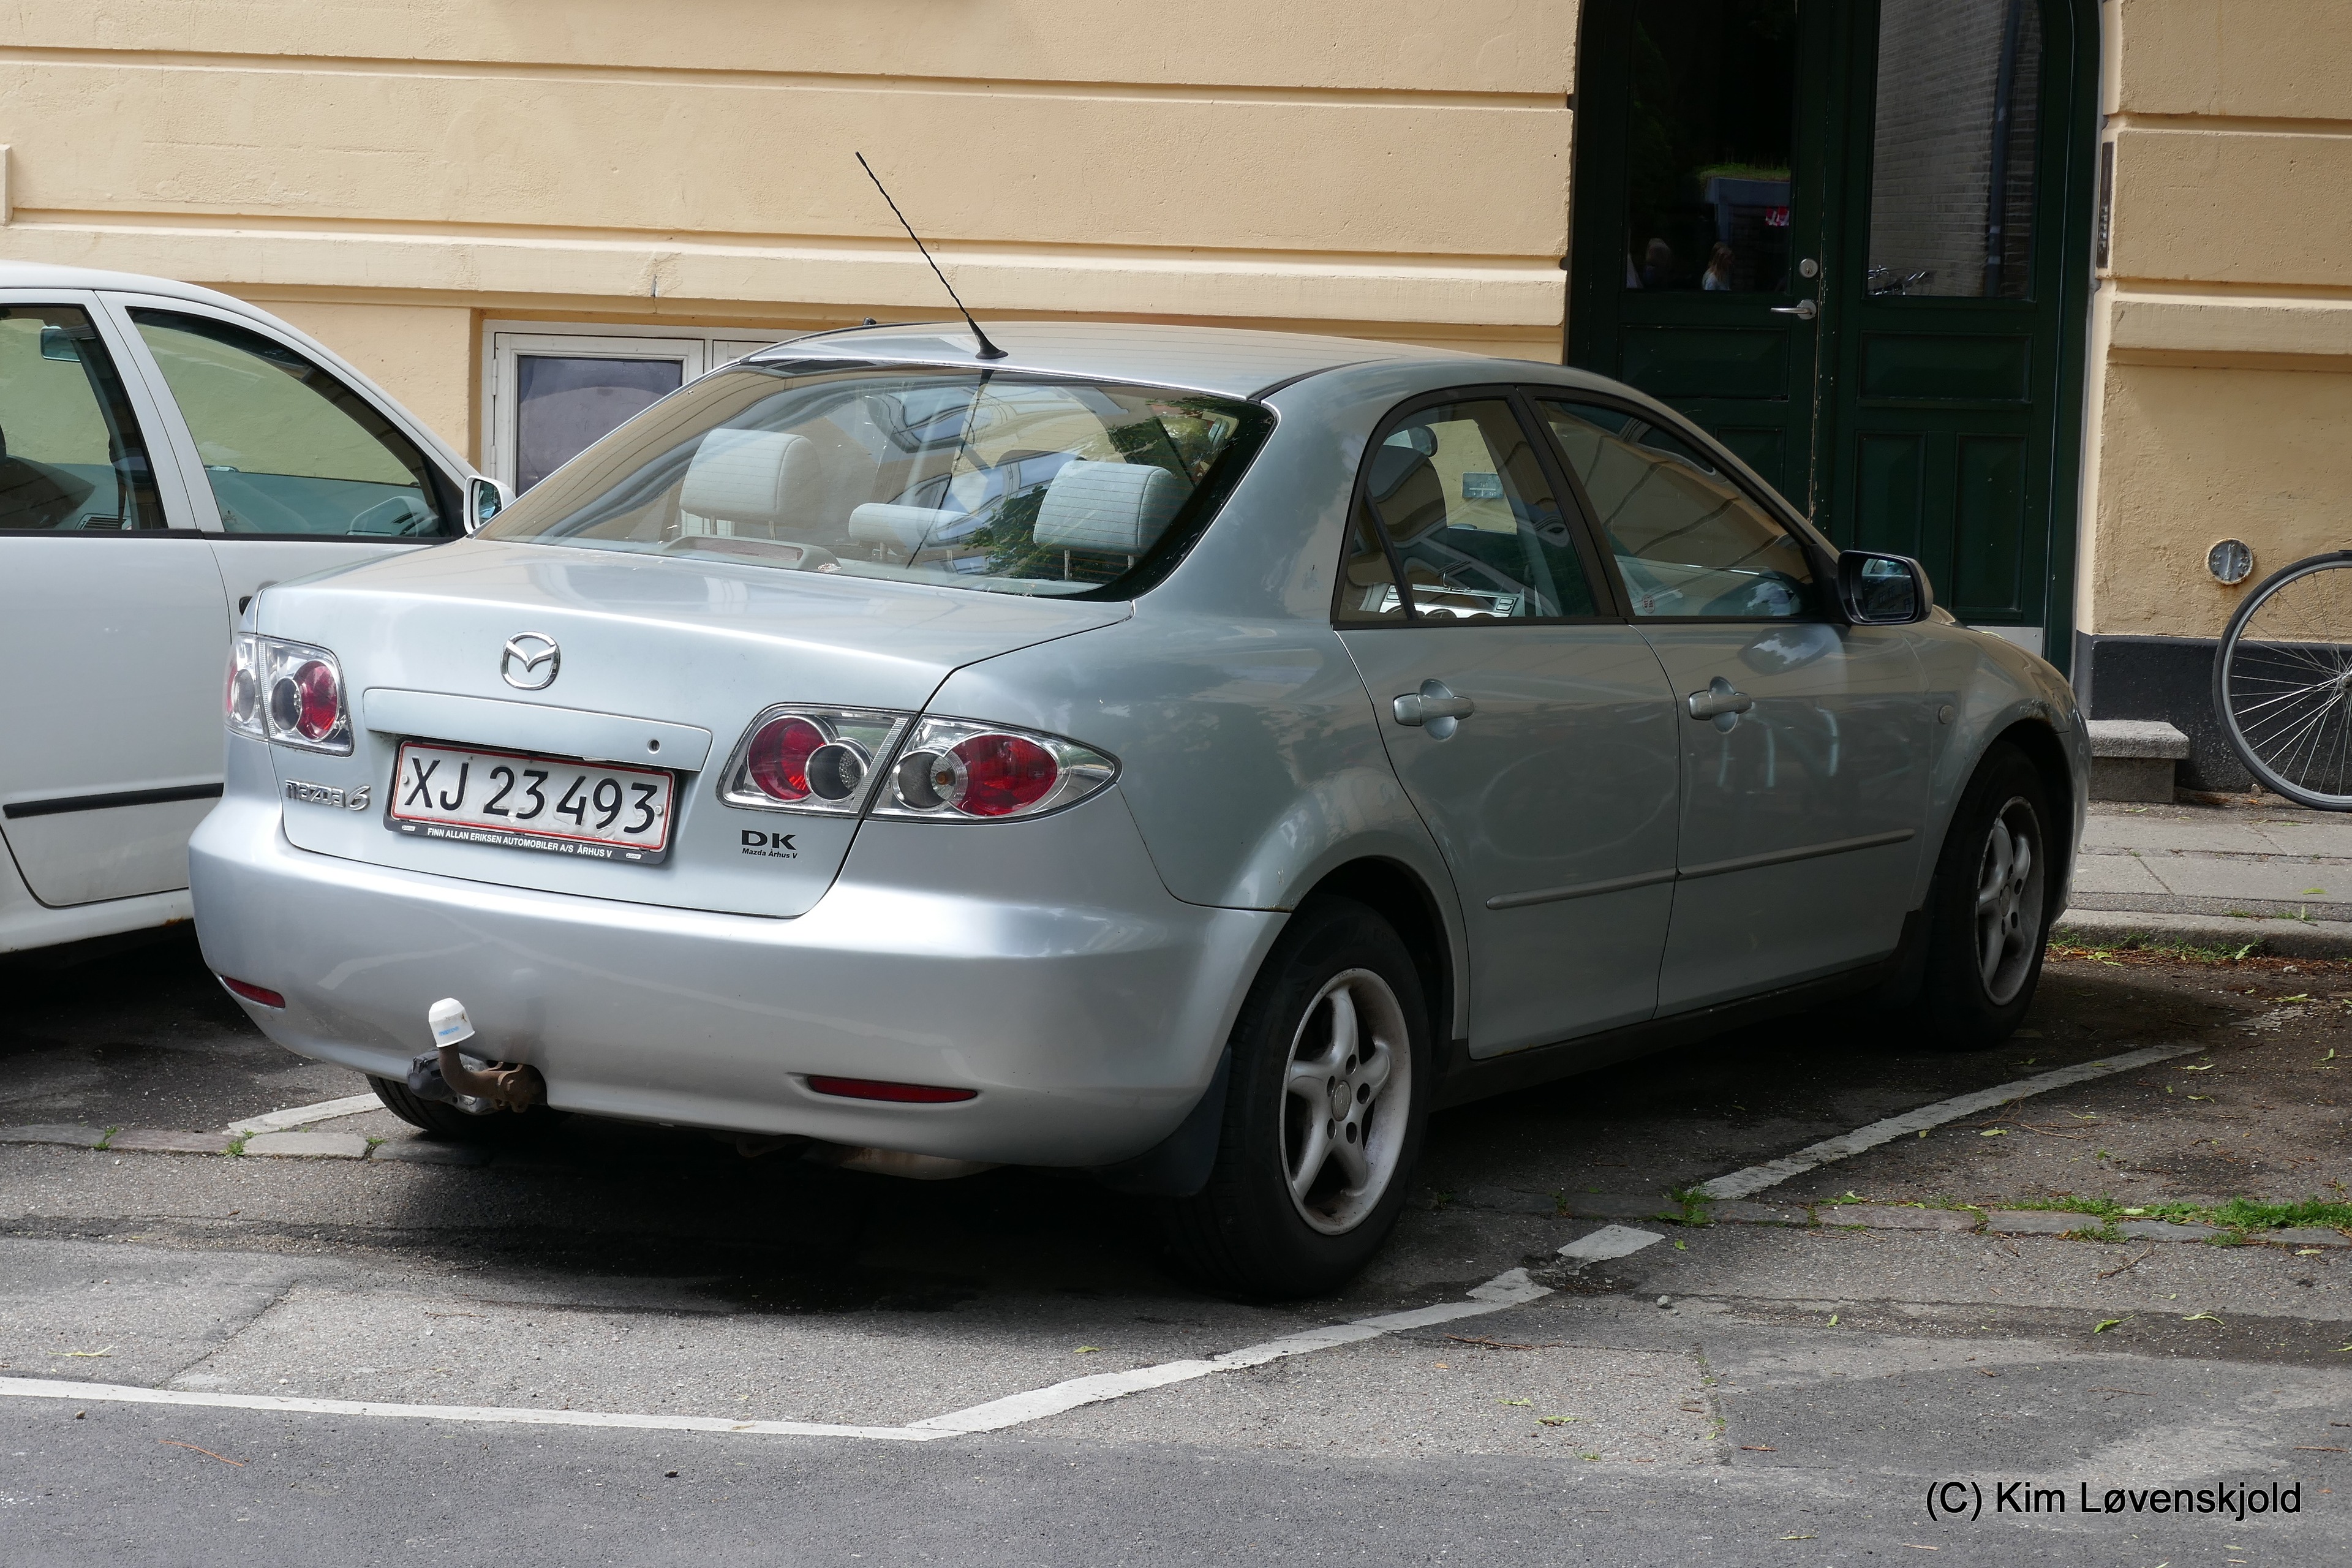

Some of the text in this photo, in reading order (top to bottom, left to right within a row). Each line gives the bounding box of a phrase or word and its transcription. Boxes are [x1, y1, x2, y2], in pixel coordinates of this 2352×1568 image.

[405, 756, 469, 811] XJ
[347, 786, 371, 810] 6
[427, 828, 445, 837] FINN
[445, 830, 469, 840] ALLAN
[470, 832, 502, 843] ERIKSEN
[503, 837, 559, 850] AUTOMOBILER
[559, 843, 574, 853] A/S
[577, 844, 605, 857] ÅRHUS
[606, 850, 612, 858] V
[742, 829, 796, 850] DK
[742, 848, 766, 856] Mazda
[768, 849, 790, 859] Århus
